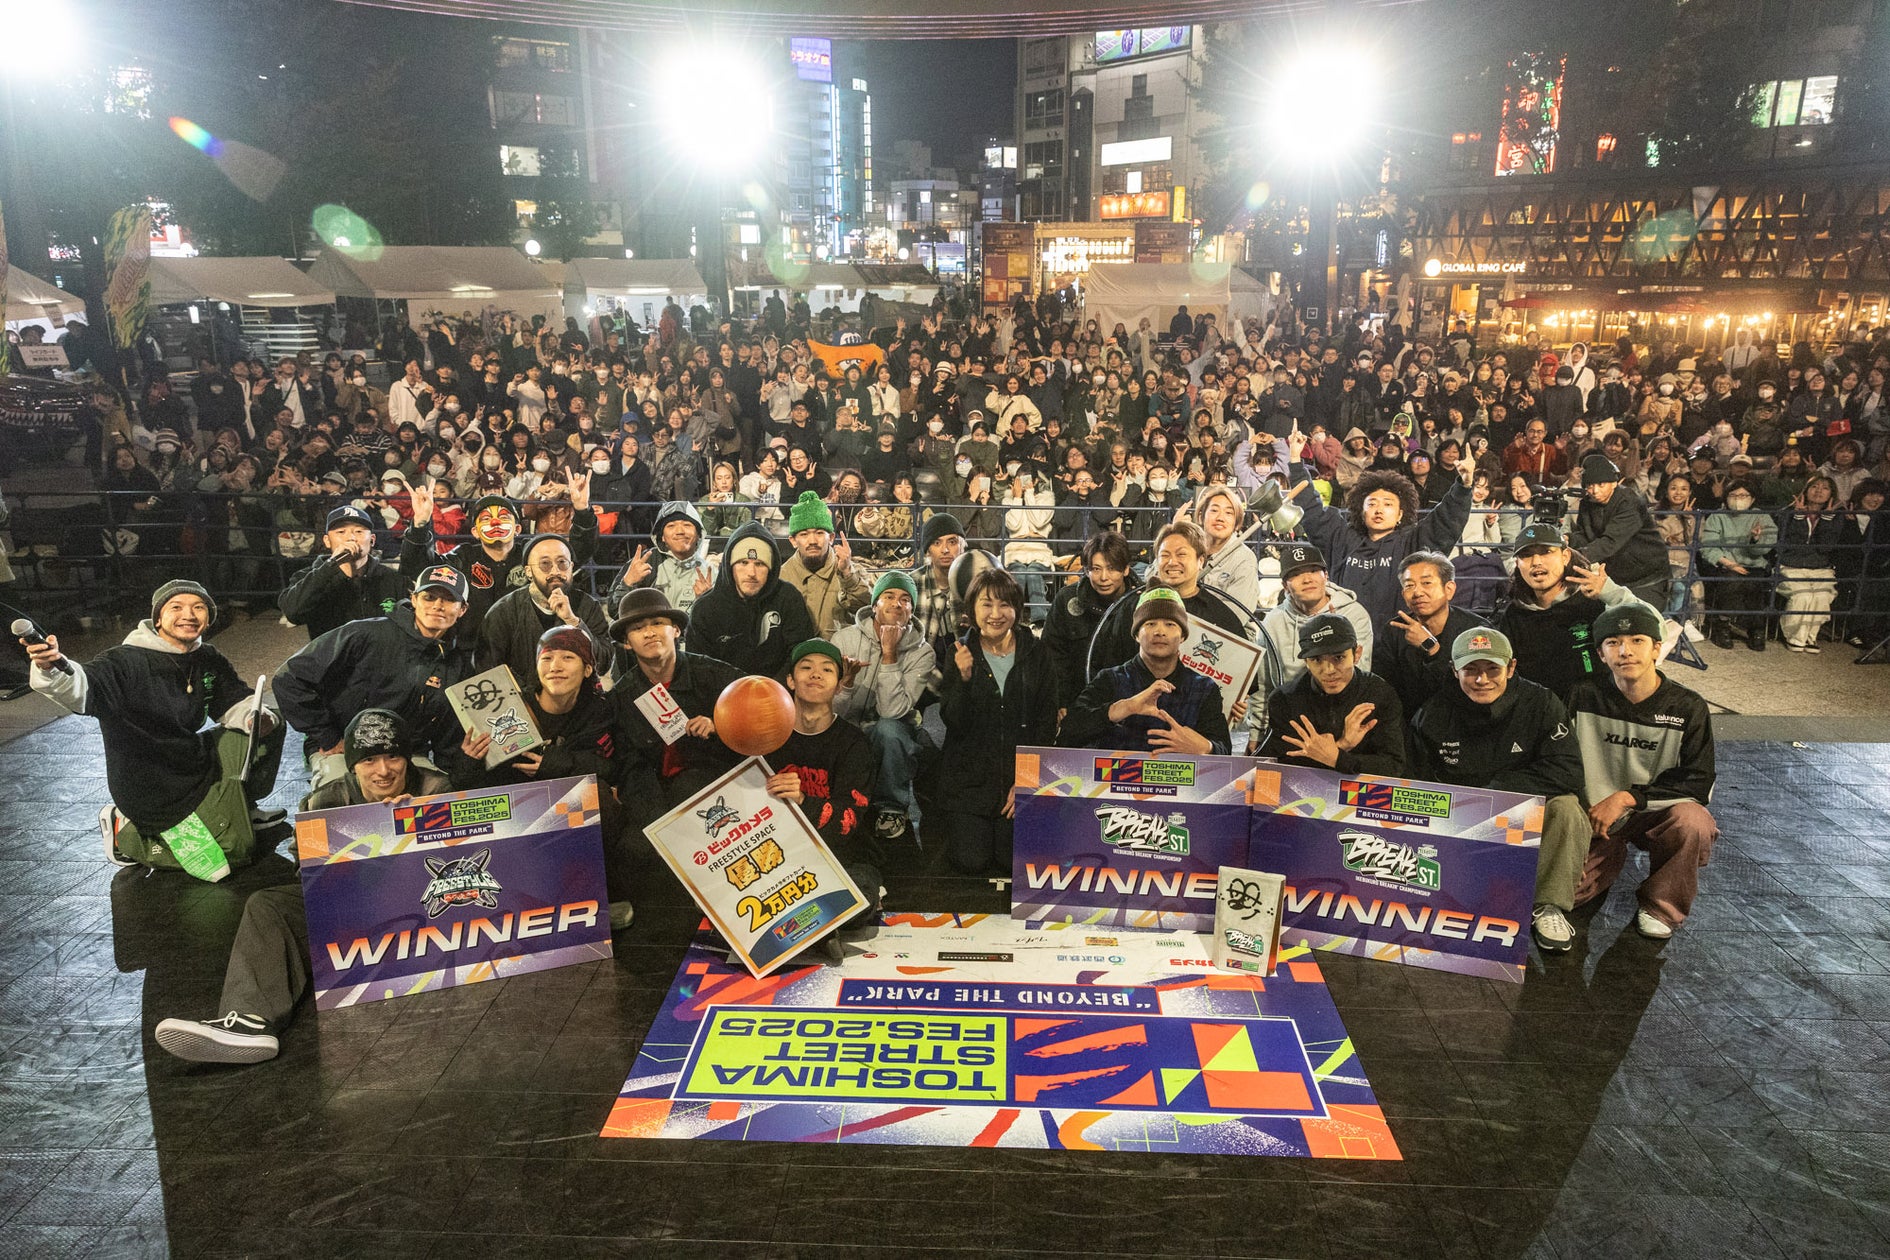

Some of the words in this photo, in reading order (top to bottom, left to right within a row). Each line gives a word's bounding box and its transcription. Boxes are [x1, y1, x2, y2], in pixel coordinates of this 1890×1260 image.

[1442, 263, 1475, 272] GLOBAL
[1477, 263, 1500, 273] RING
[1502, 261, 1526, 273] CAFÉ
[1181, 654, 1233, 685] ビックカメラ
[1603, 732, 1659, 751] XLARGE
[1144, 762, 1191, 771] TOSHIMA
[1144, 769, 1184, 777] STREET
[1144, 776, 1193, 784] FES.2025
[453, 797, 506, 809] TOSHIMA
[1394, 796, 1437, 807] STREET
[1395, 790, 1447, 802] TOSHIMA
[453, 805, 497, 816] STREET
[1393, 803, 1447, 815] FES.2025
[454, 811, 509, 824] FES.2025
[1391, 814, 1403, 822] THE
[454, 829, 467, 837] THE
[707, 806, 774, 855] ビックカメラ
[708, 841, 751, 873] FREESTYLE
[750, 823, 776, 844] SPACE
[1170, 834, 1187, 852] ST.
[724, 838, 785, 891] 優勝
[1025, 863, 1218, 900] WINNE
[1419, 866, 1437, 887] ST.
[420, 871, 502, 904] FREESTYLE
[1399, 885, 1431, 897] CHAMPIONSHIP
[736, 871, 819, 933] 2万円分
[326, 900, 599, 971] WINNER
[955, 988, 1005, 1003] THE
[719, 1018, 996, 1042] FES.2025
[764, 1041, 996, 1066] STREET
[711, 1064, 998, 1092] TOSHIMA
